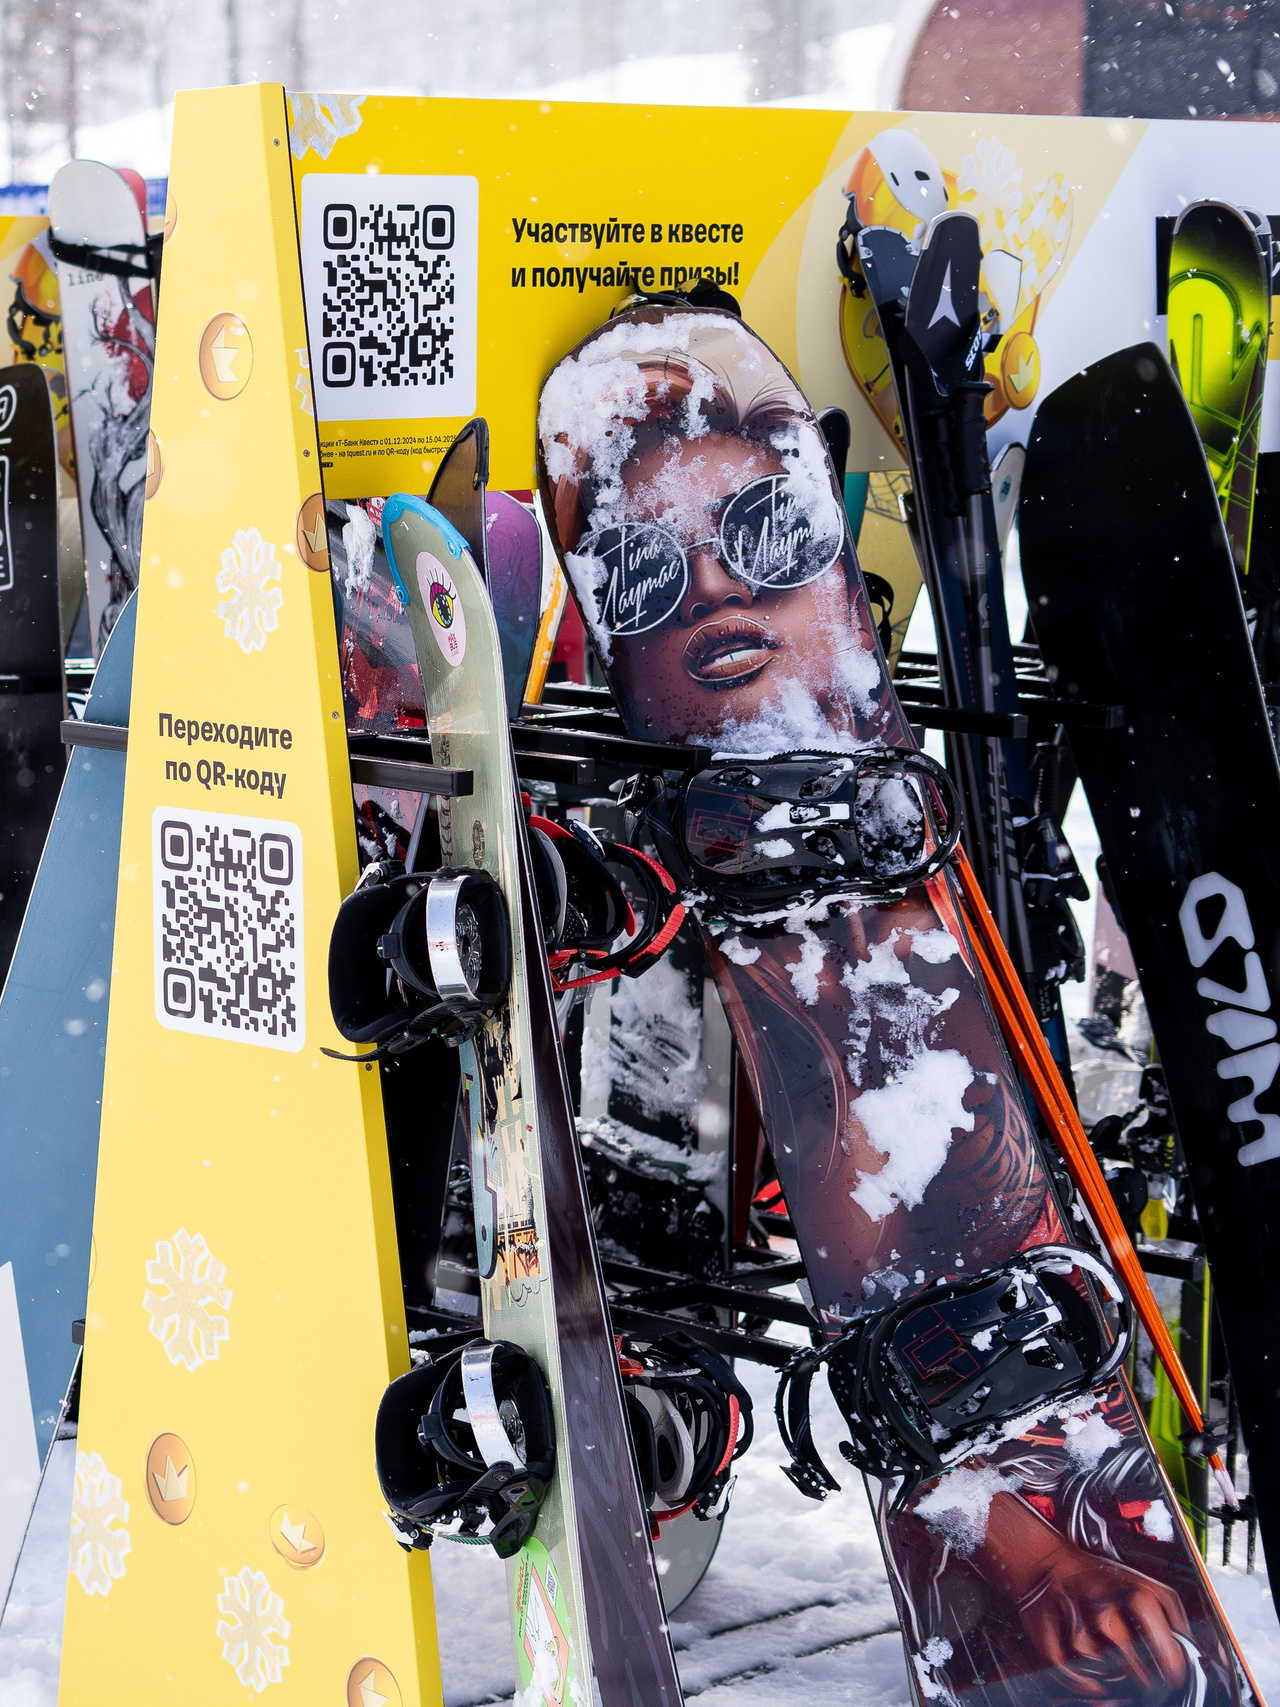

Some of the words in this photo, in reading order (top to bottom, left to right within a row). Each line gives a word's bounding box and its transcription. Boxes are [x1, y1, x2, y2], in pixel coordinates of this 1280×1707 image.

[511, 217, 645, 249] Участвуйте
[650, 223, 663, 243] в
[669, 223, 744, 243] квесте
[511, 267, 526, 287] и
[532, 261, 655, 293] получайте
[660, 262, 739, 288] призы!
[384, 437, 417, 445] 01.12.2024
[158, 712, 293, 750] Переходите
[165, 760, 192, 782] по
[196, 759, 287, 799] QR-коду
